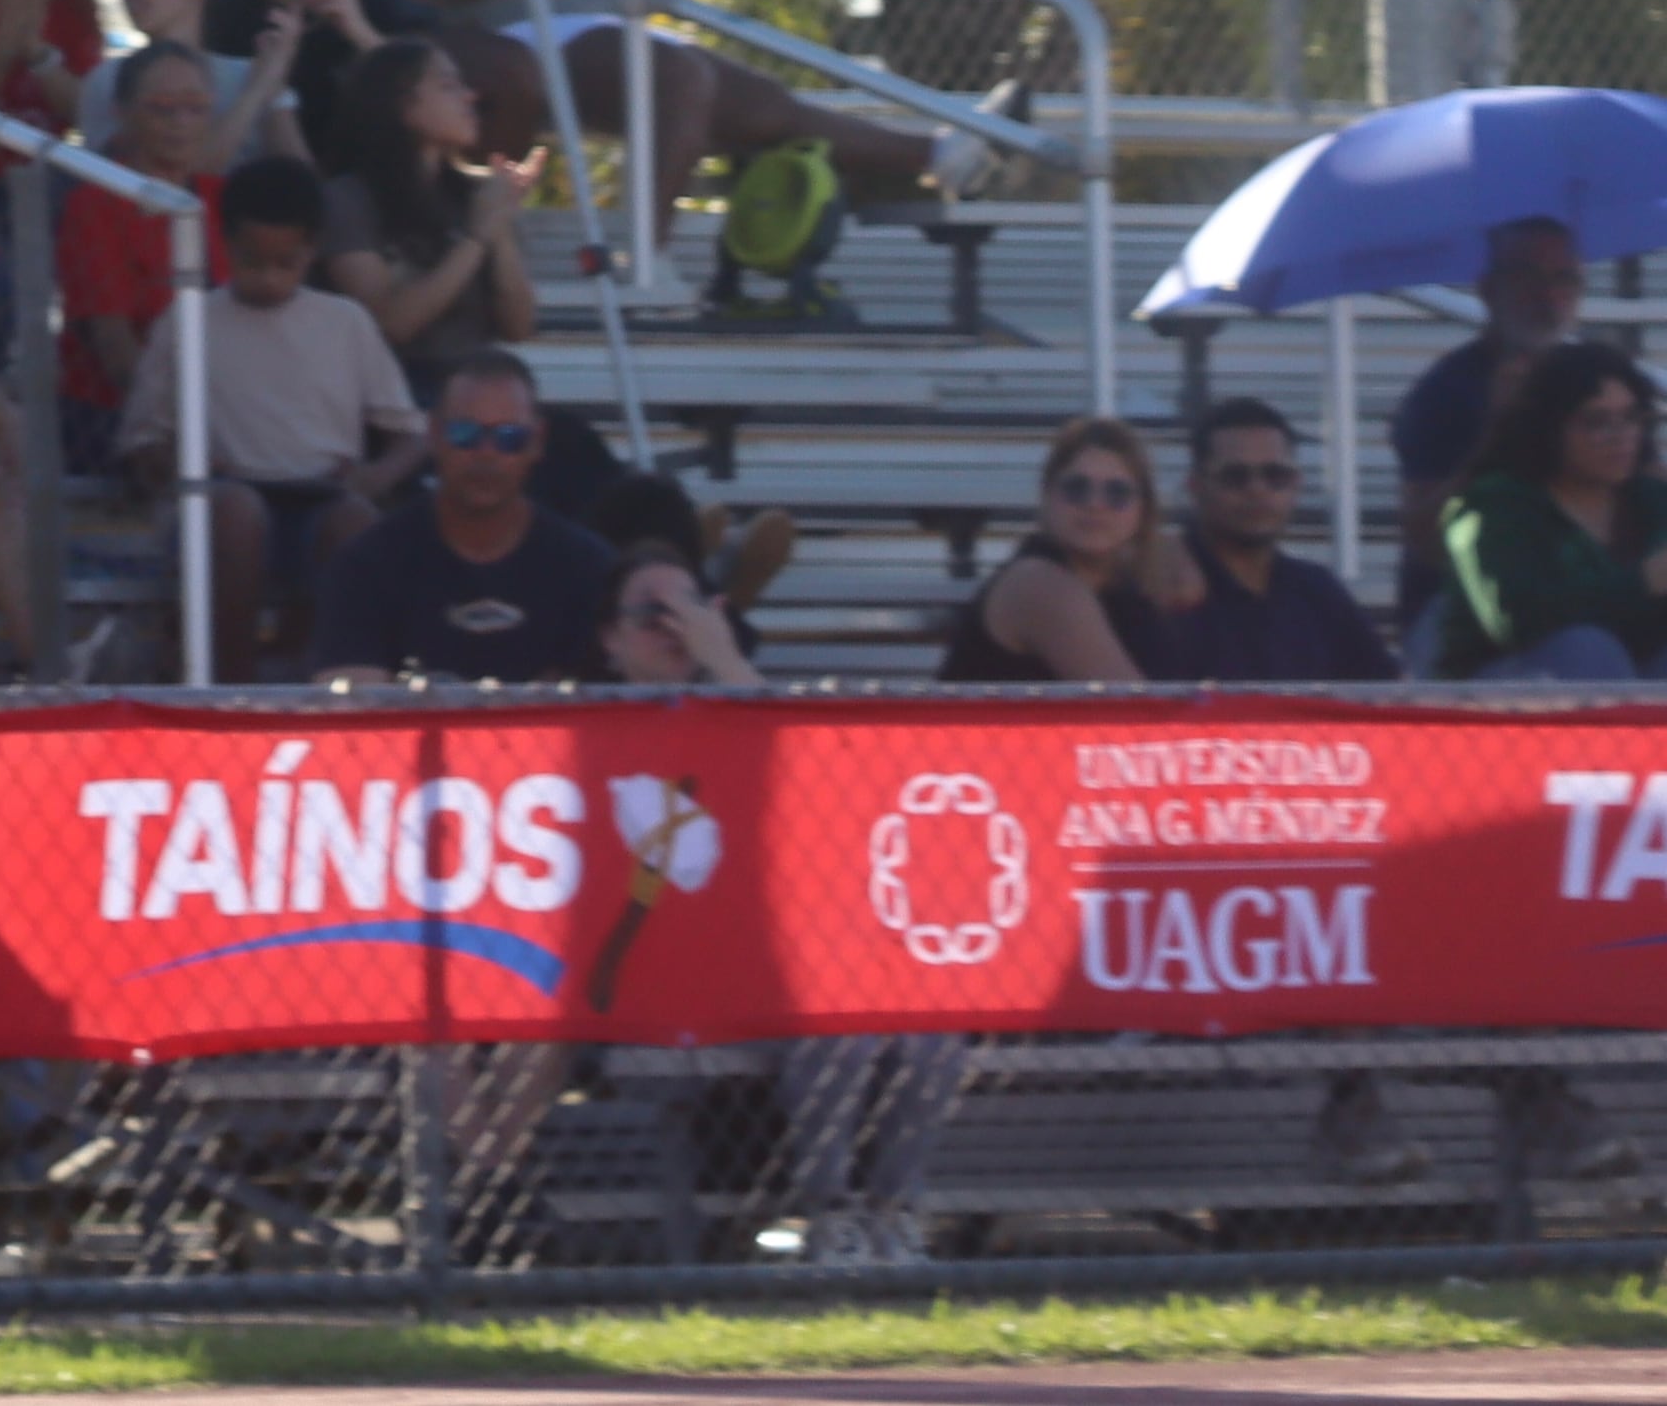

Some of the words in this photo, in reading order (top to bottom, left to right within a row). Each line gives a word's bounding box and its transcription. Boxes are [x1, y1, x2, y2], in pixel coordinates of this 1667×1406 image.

[1074, 738, 1374, 788] UNIVERSIDAD
[79, 740, 587, 922] TAÍNOS
[1057, 802, 1155, 847] ANA
[1202, 788, 1387, 845] MÉNDEZ
[1069, 884, 1376, 993] UAGM
